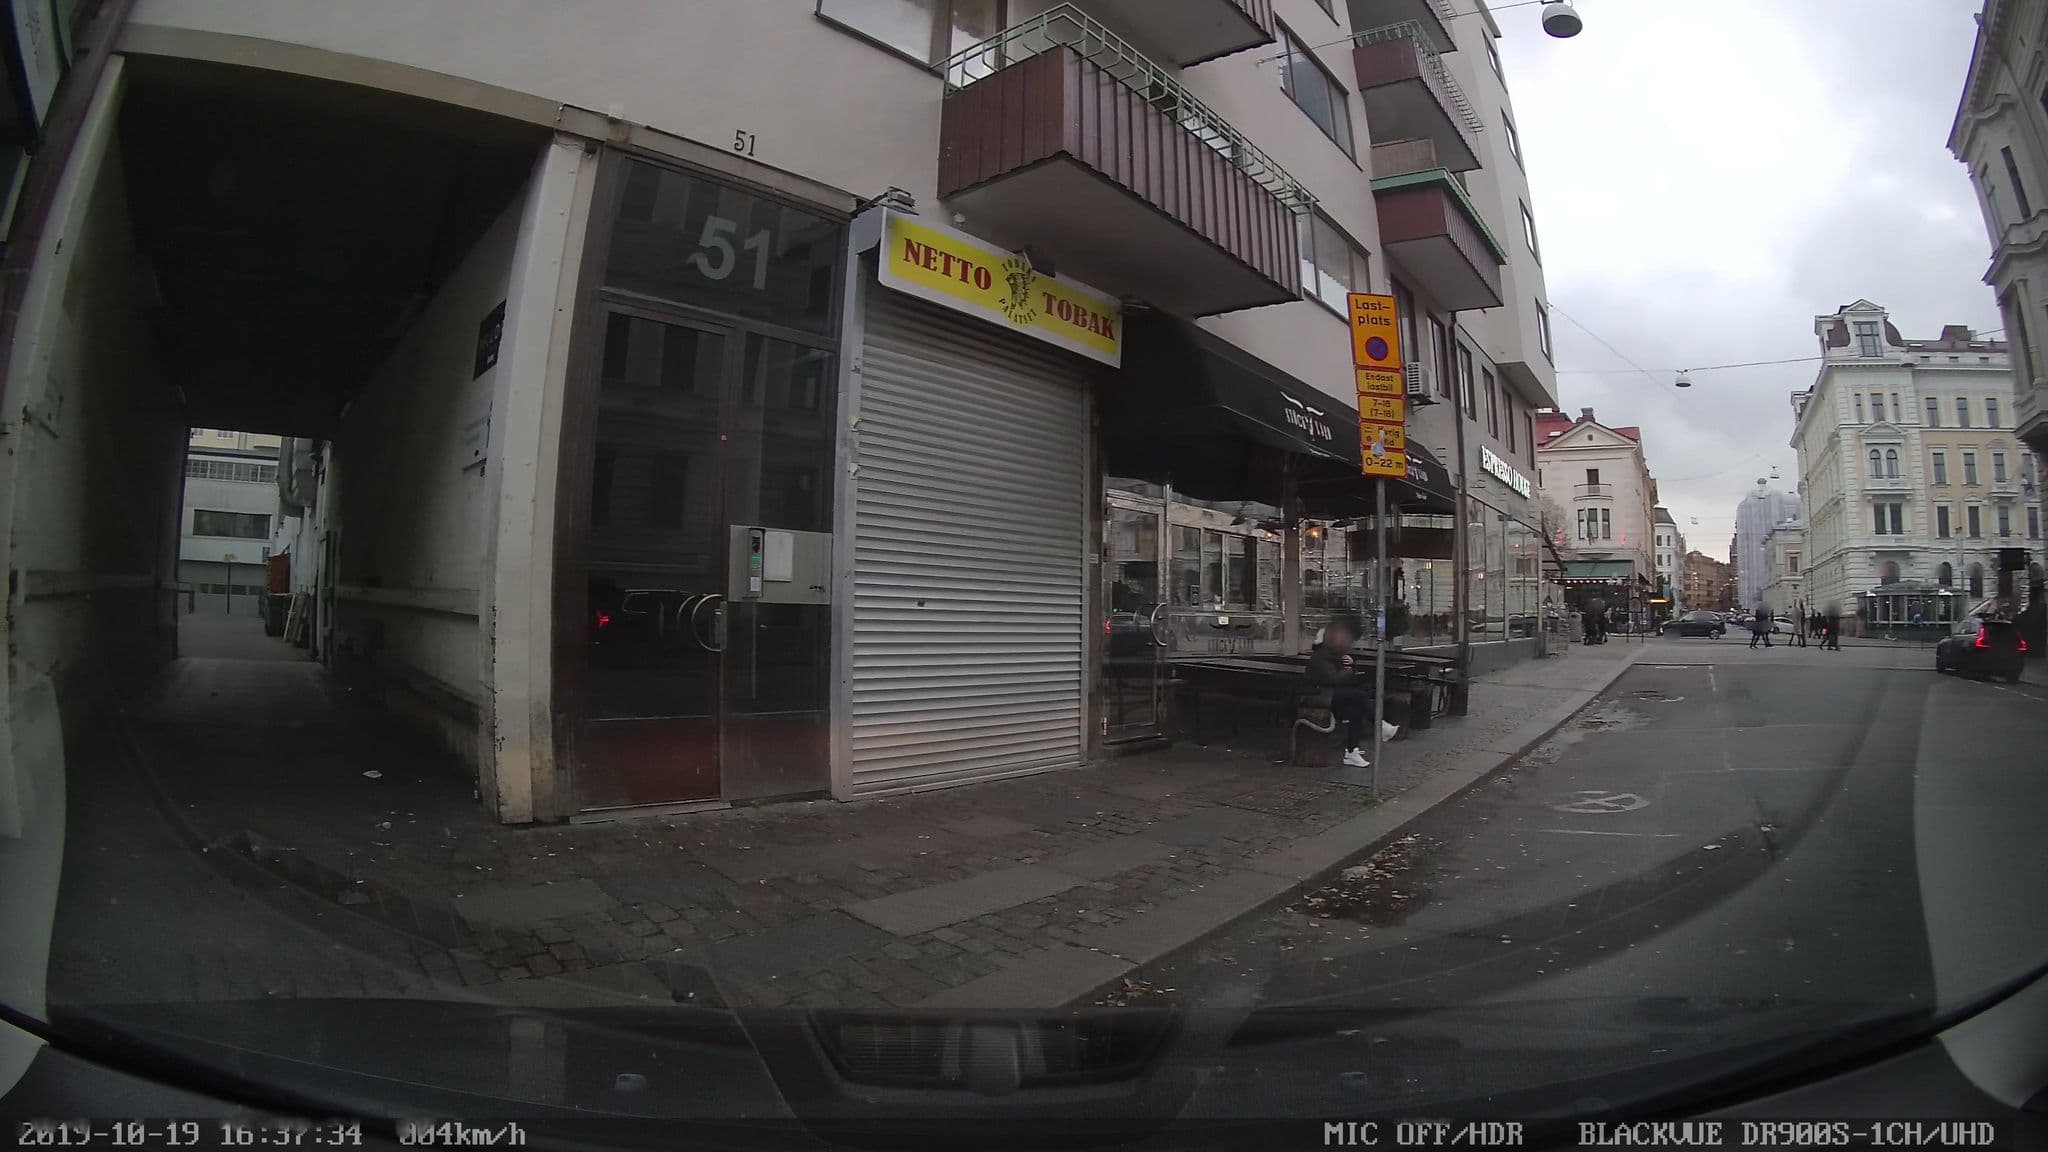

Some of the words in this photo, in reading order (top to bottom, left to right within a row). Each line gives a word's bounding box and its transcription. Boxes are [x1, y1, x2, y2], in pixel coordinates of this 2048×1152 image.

[733, 129, 756, 157] 51
[689, 215, 770, 291] 51
[903, 237, 993, 291] NETTO
[1042, 291, 1116, 342] TOBAK
[1354, 298, 1390, 311] Last-
[1357, 314, 1391, 327] plats
[1365, 372, 1394, 382] Endast
[1367, 383, 1393, 392] lastbil
[1365, 457, 1393, 468] 0-22
[1395, 461, 1404, 470] m
